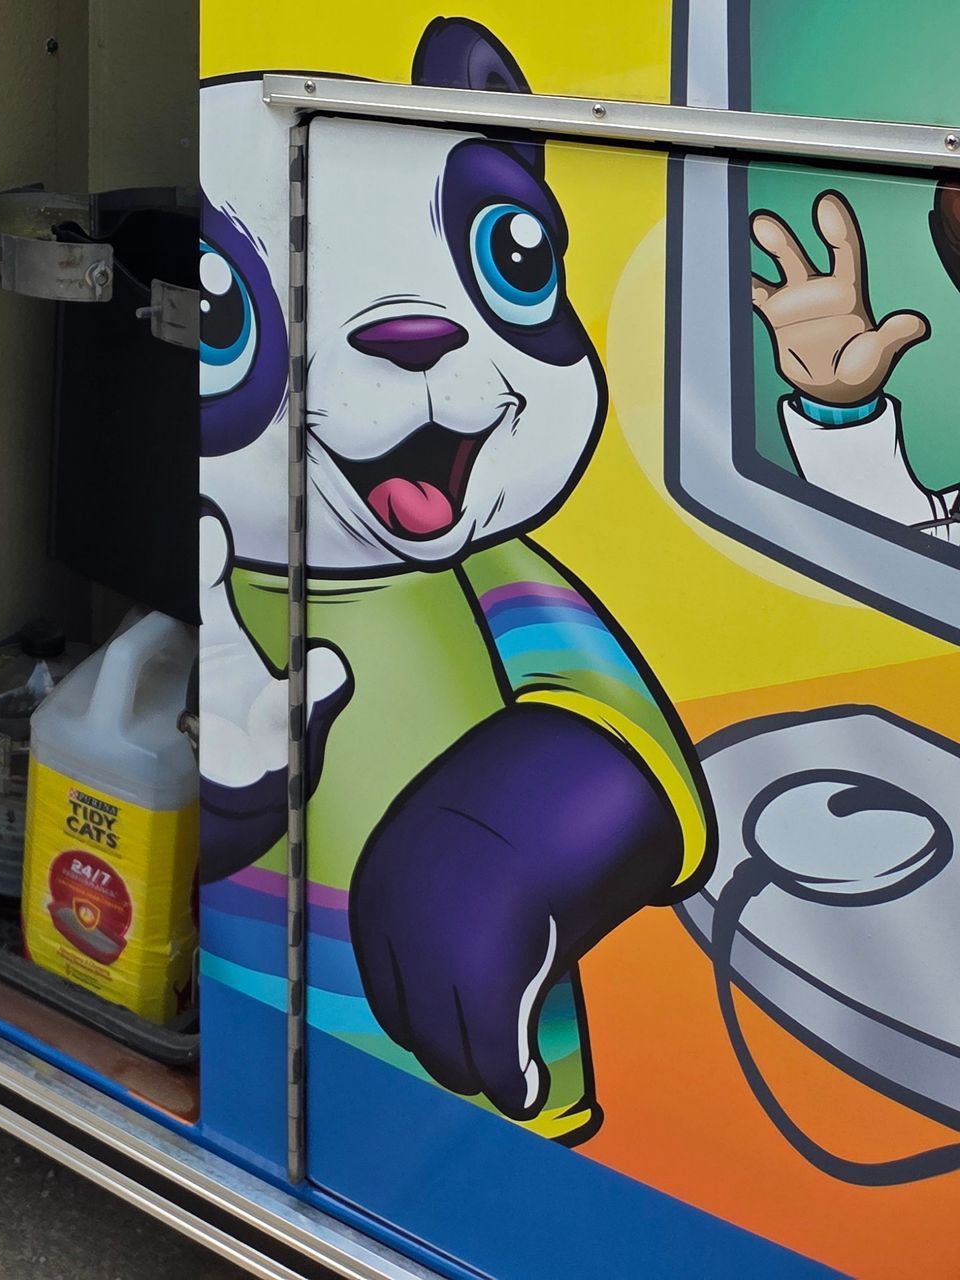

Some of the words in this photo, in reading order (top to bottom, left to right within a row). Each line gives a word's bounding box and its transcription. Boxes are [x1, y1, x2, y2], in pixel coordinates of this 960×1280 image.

[68, 799, 117, 831] TIDY
[78, 793, 117, 815] PURINA
[66, 815, 118, 849] CATS
[70, 858, 112, 887] 24/7
